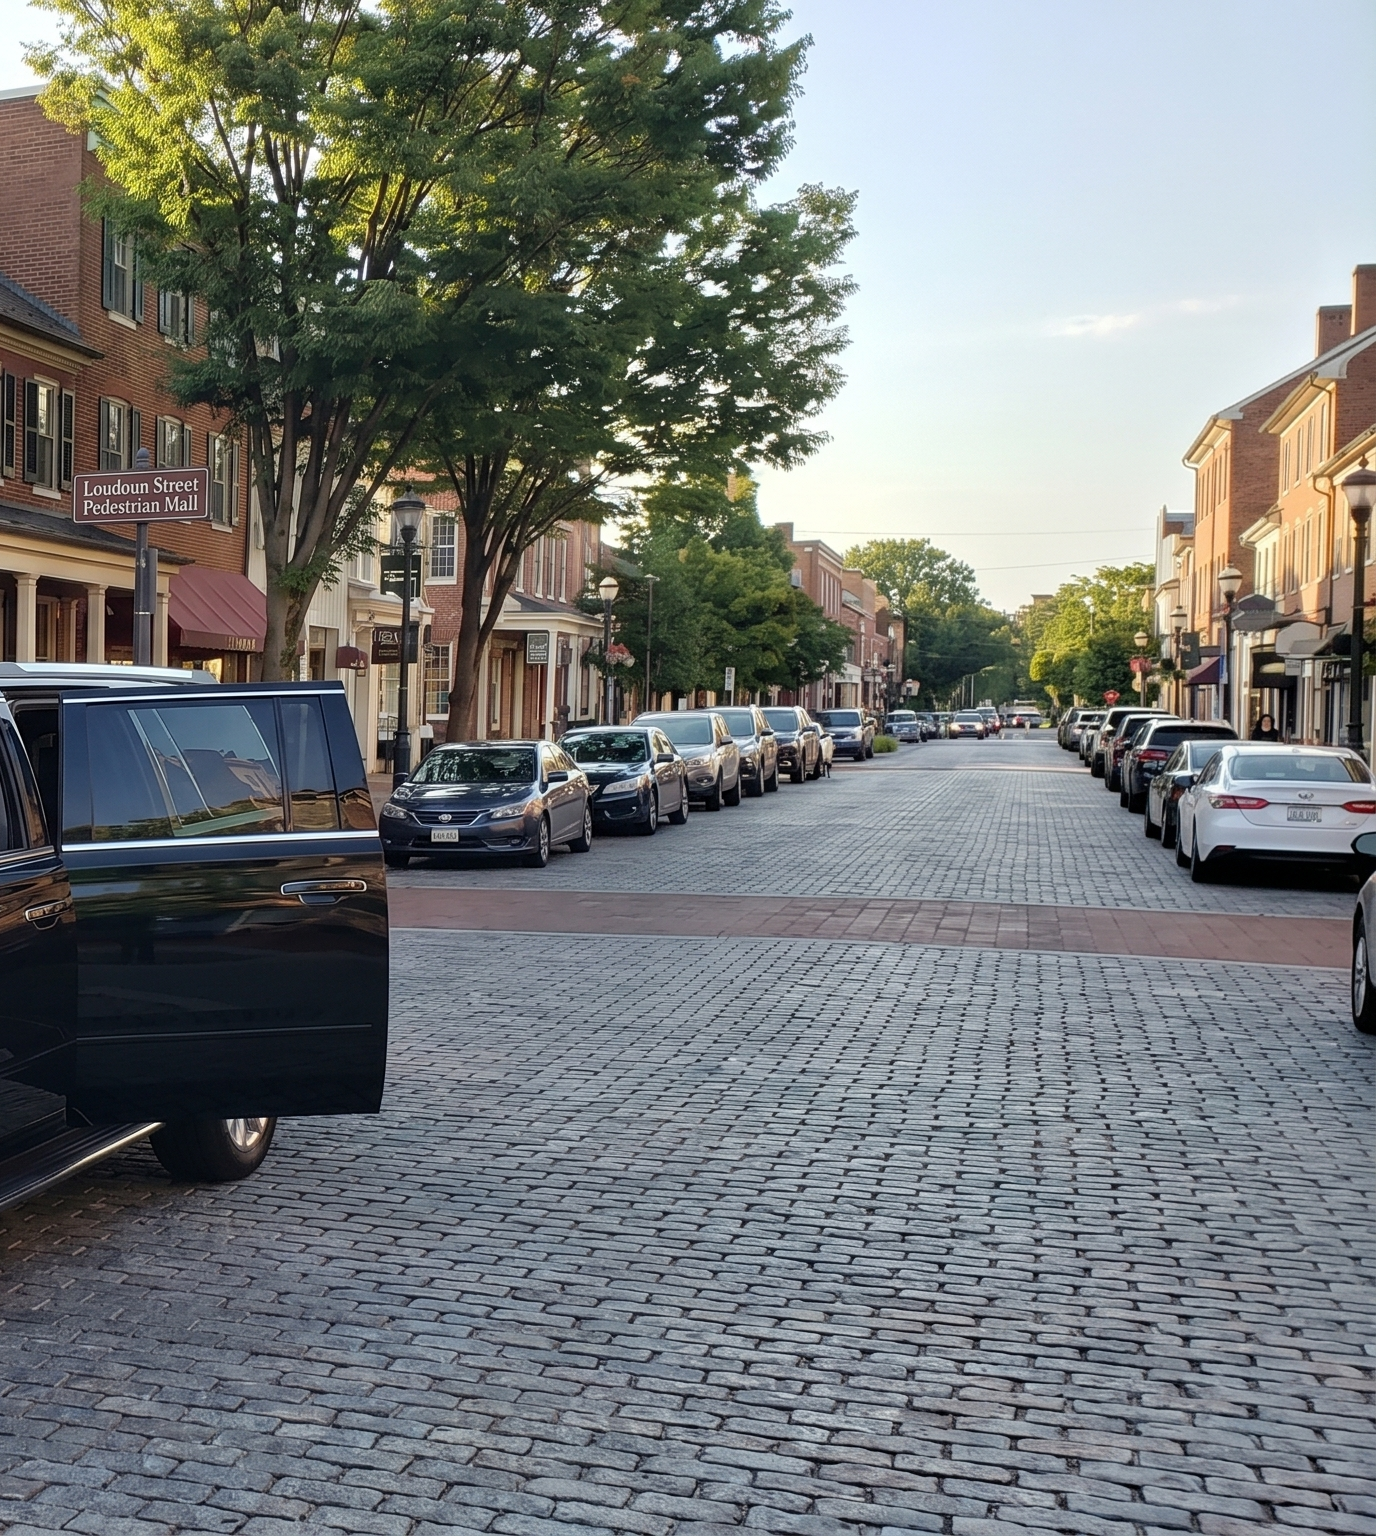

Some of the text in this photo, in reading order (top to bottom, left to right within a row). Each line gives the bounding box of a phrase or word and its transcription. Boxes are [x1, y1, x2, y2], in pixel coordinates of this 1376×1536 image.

[83, 476, 199, 497] Loudoun Street
[83, 495, 198, 516] Pedestrian Mall
